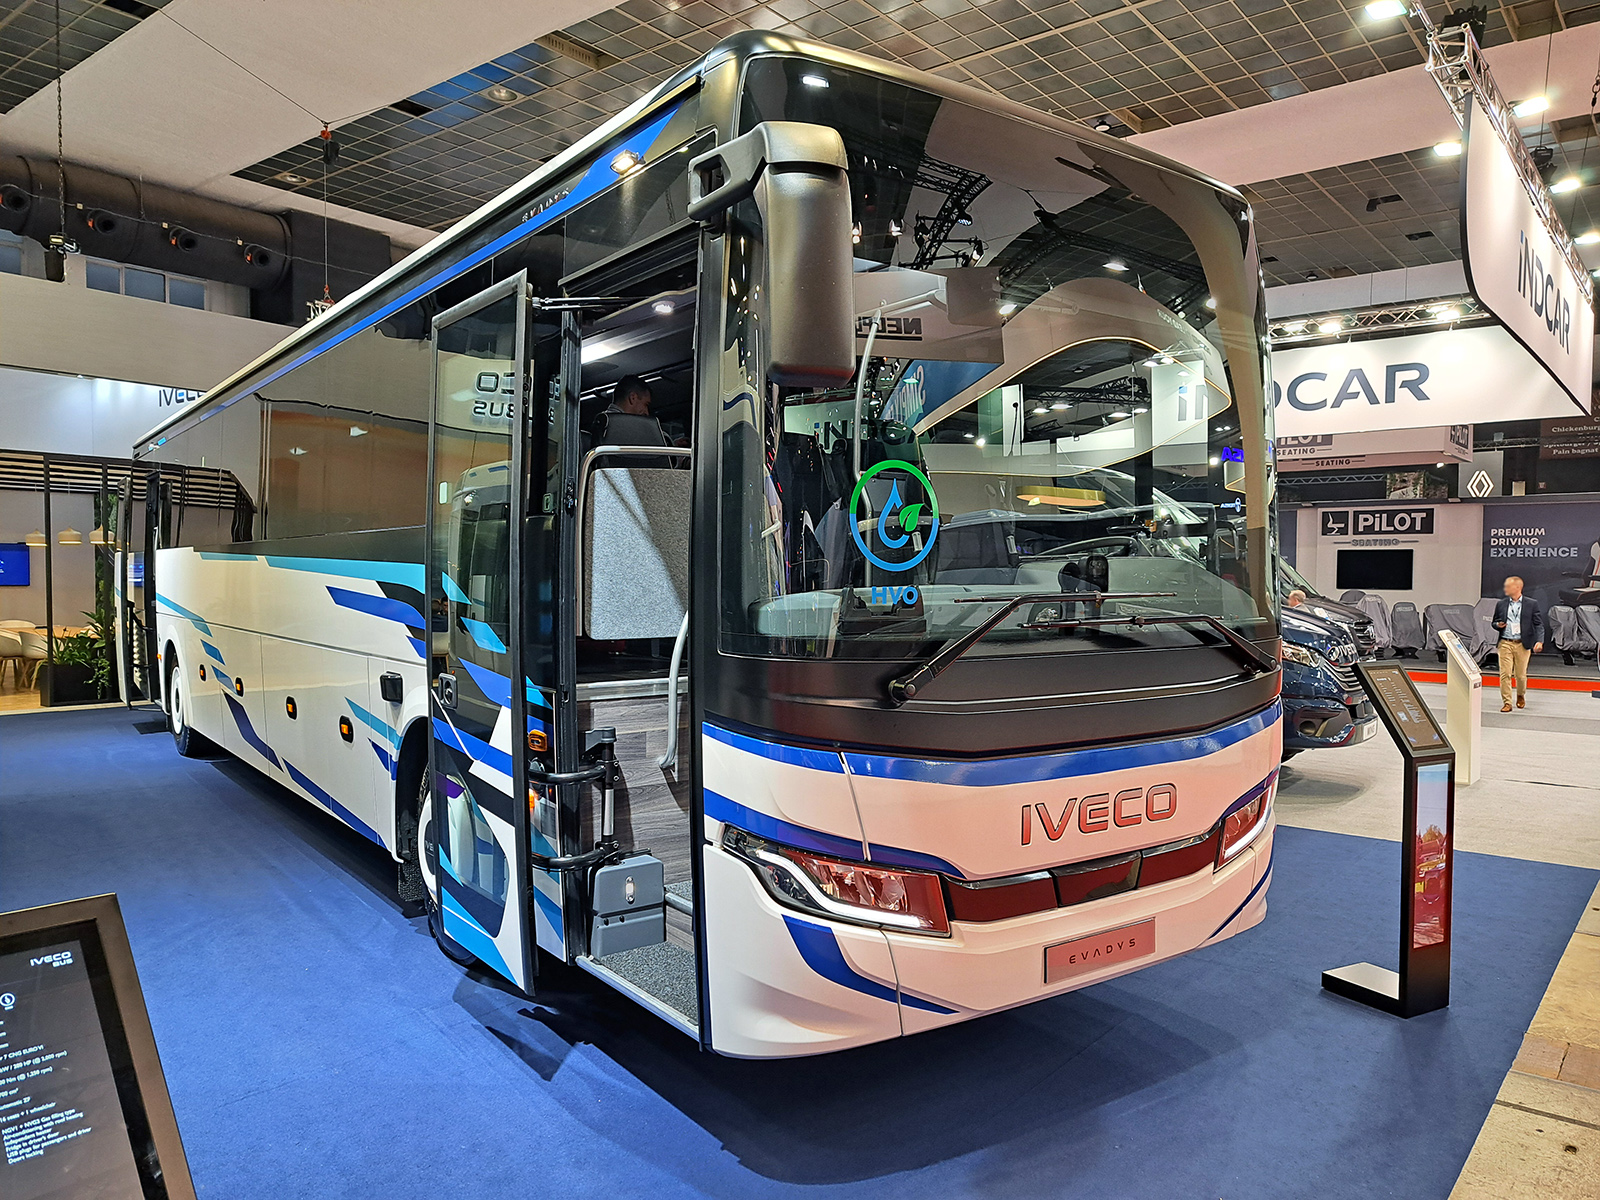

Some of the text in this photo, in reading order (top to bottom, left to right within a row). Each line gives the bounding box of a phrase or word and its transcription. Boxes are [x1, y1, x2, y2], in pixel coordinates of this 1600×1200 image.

[1276, 447, 1316, 456] SEATING
[1315, 458, 1351, 467] SEATING
[1490, 527, 1546, 537] PREMIUM
[1351, 538, 1400, 547] SEATING
[1490, 537, 1540, 546] DRIVING
[1490, 547, 1579, 558] EXPERIENCE
[871, 586, 919, 605] HVO
[1020, 782, 1178, 846] IVECO
[1068, 938, 1137, 965] EVADYS
[29, 951, 72, 967] IVECO
[52, 958, 74, 968] BUS
